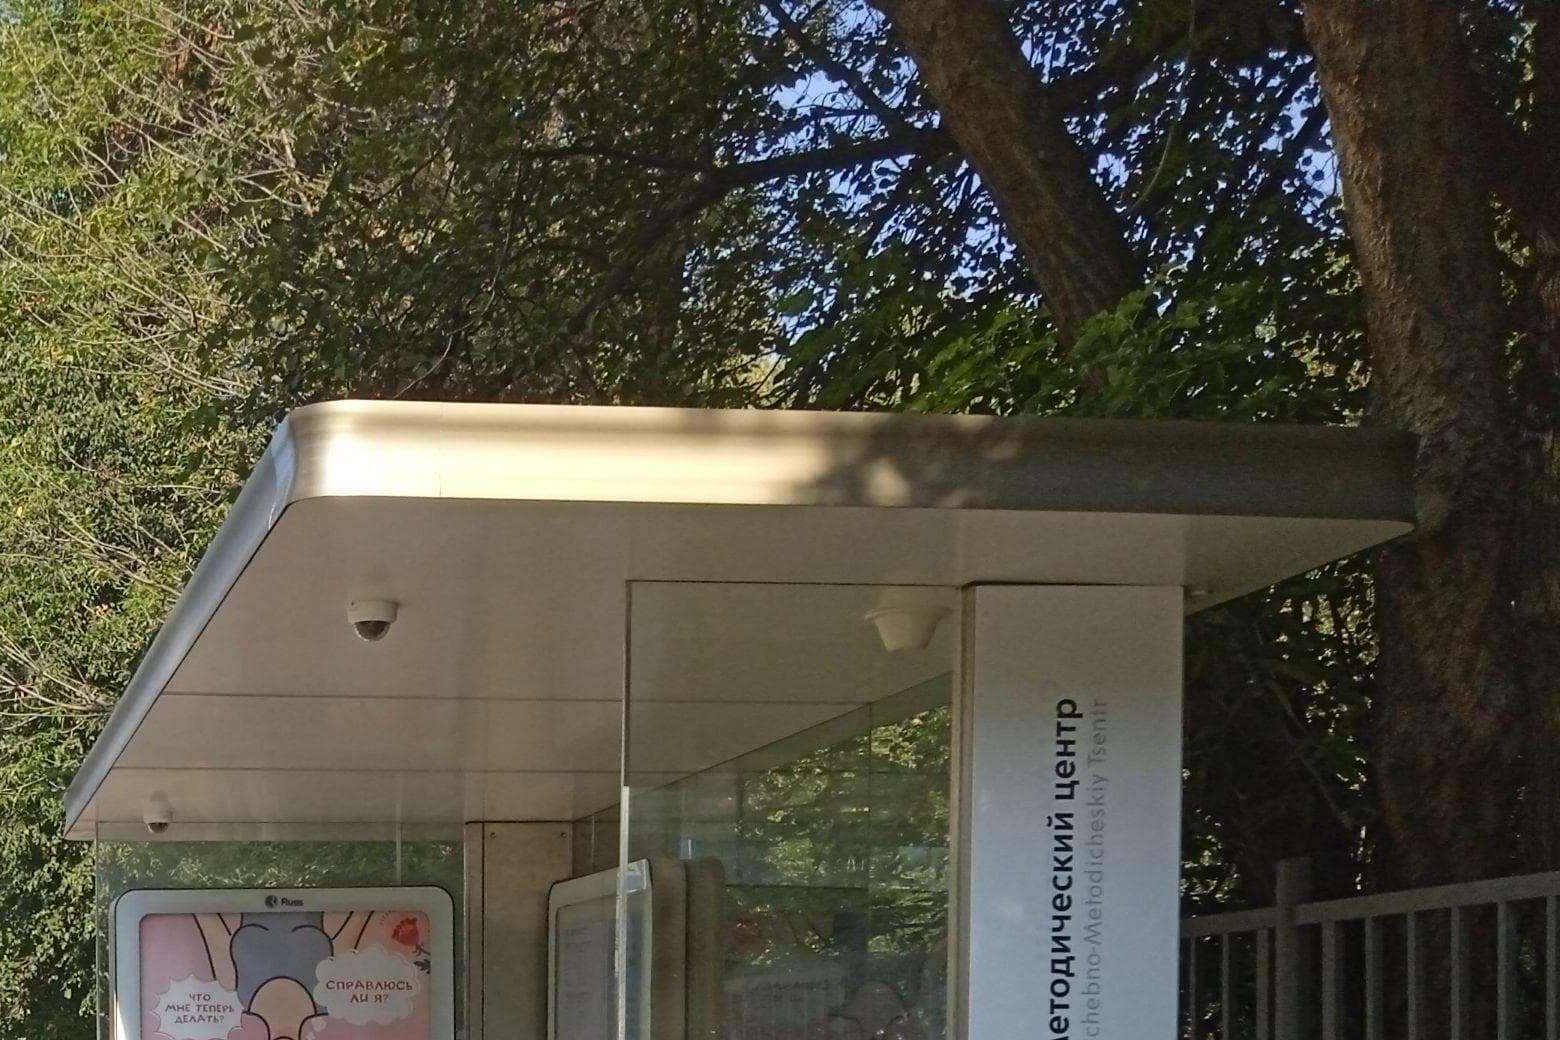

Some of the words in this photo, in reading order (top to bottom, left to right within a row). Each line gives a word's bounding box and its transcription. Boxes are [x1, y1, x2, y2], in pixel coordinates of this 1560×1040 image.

[1087, 699, 1107, 766] Tsentr
[1054, 698, 1083, 800] центр
[326, 980, 413, 991] СПРАВЛЮСЬ
[189, 993, 211, 1002] ЧТО
[350, 993, 369, 1003] ЛИ
[374, 993, 389, 1003] Я?
[165, 1004, 190, 1012] МНЕ
[196, 1004, 235, 1013] ТЕПЕРЬ
[174, 1014, 225, 1024] ДЕЛАТЬ?
